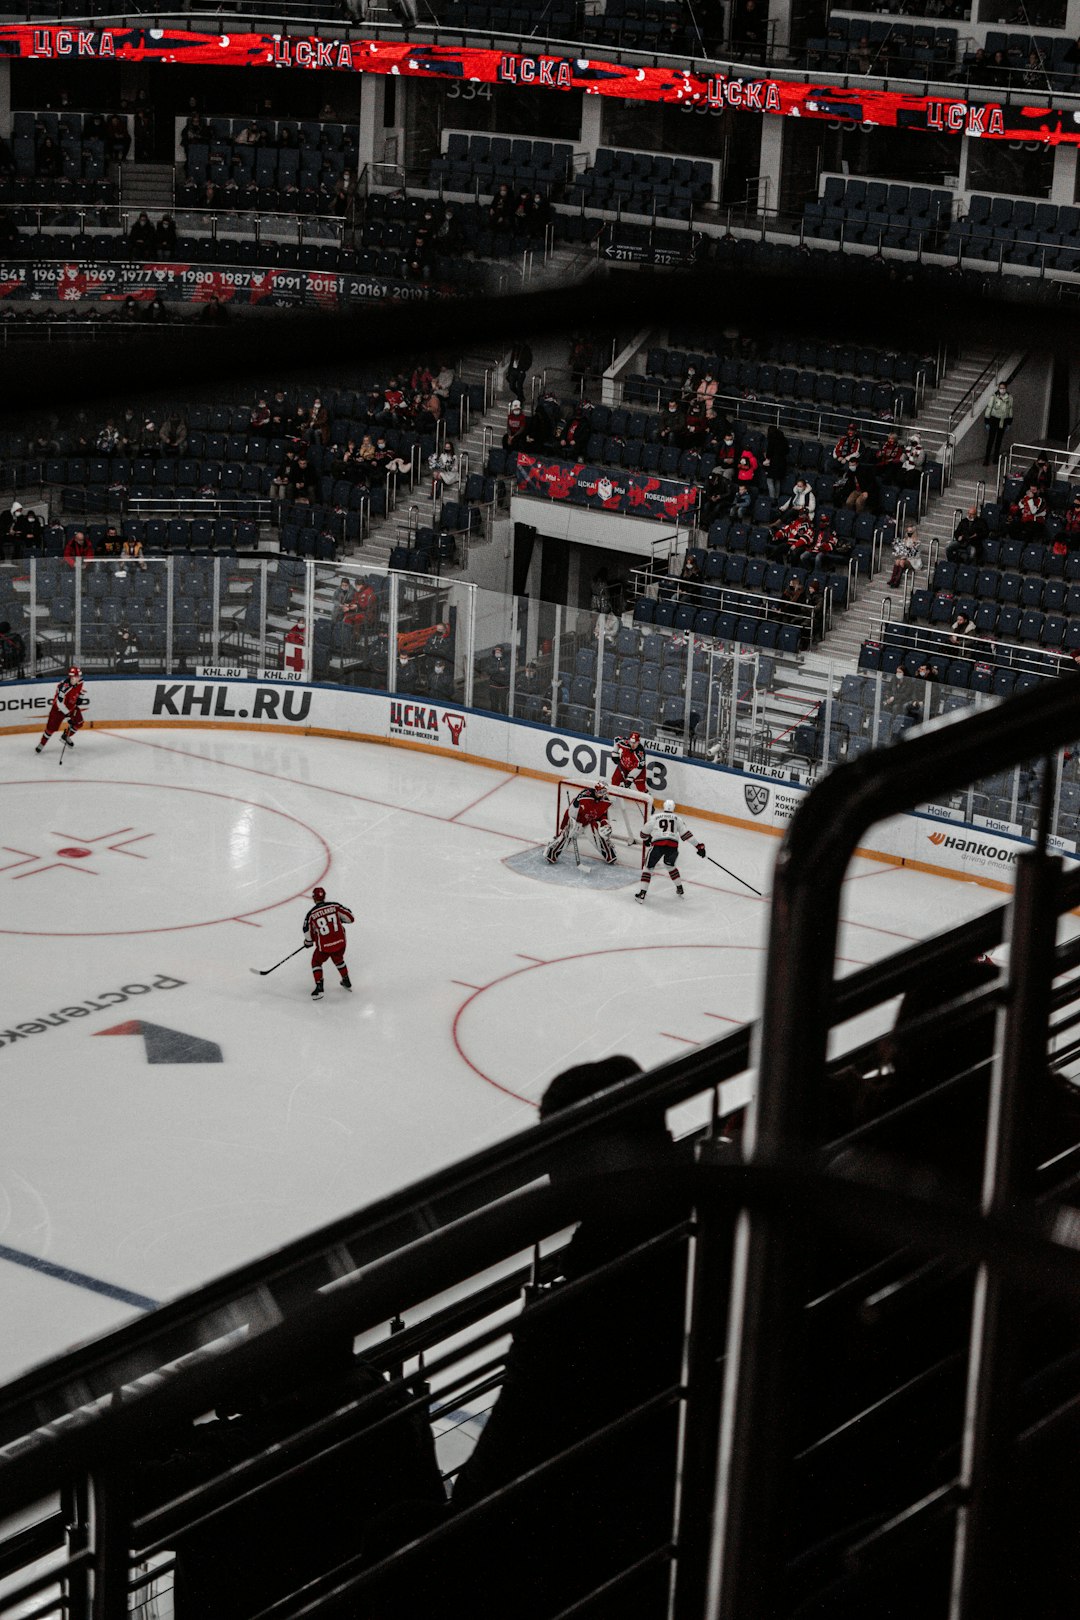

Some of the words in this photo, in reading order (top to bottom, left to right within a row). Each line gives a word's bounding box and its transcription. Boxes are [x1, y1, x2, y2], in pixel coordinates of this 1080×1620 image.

[34, 30, 115, 57] ЦСКА
[272, 39, 353, 67] ЦСКА
[501, 56, 573, 86] ЦСКА
[707, 78, 781, 111] ЦСКА
[926, 102, 1005, 134] ЦСКА
[616, 250, 633, 260] 211
[655, 254, 672, 264] 212
[33, 269, 65, 281] 1963
[84, 269, 116, 282] 1969
[121, 270, 152, 282] 1977
[181, 271, 214, 283] 1980
[220, 272, 251, 286] 1987
[272, 276, 301, 289] 1991
[306, 279, 337, 293] 2015
[351, 282, 381, 297] 2016
[578, 480, 597, 489] ЦСКА!
[644, 492, 678, 504] ПОБЕДИМ!
[203, 668, 241, 677] KHL.RU
[264, 671, 301, 681] KHL.RU
[152, 684, 312, 722] KHL.RU
[391, 701, 439, 732] ЦСКА
[644, 740, 678, 755] KHL.RU
[545, 737, 668, 791] СОГЗ
[749, 764, 785, 779] KHL.RU
[927, 805, 951, 818] Haier
[658, 818, 675, 833] 91
[985, 818, 1010, 832] Haier
[961, 853, 986, 866] driving
[316, 913, 339, 936] 87
[0, 974, 188, 1048] Ростелек
